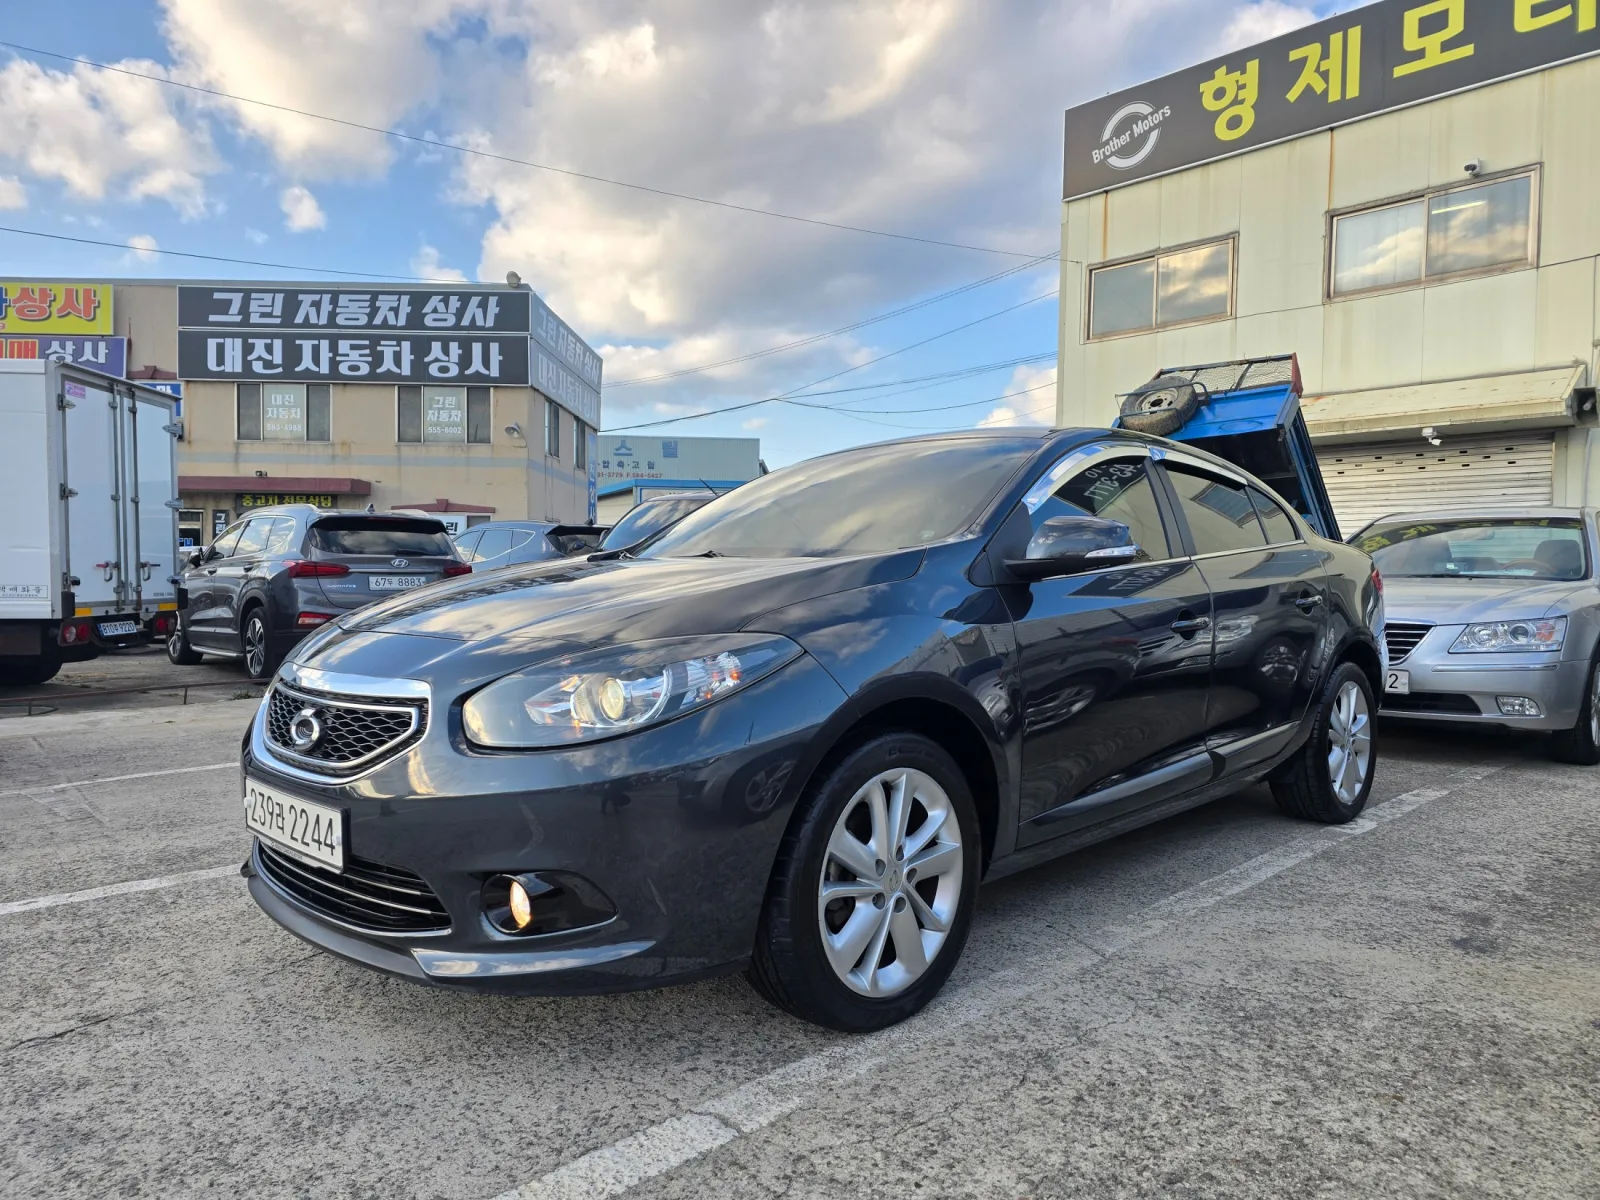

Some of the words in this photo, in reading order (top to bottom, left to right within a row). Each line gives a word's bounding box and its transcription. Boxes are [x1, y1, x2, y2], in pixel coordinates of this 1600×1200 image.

[1092, 130, 1130, 164] Brother
[1132, 105, 1171, 138] Motors
[207, 291, 286, 324] 그린
[293, 292, 413, 328] 자동차
[421, 294, 501, 329] 상사
[45, 340, 109, 364] 상사
[537, 307, 557, 349] 그린
[558, 325, 584, 372] 자동차
[584, 351, 600, 385] 상사
[206, 337, 284, 375] 대진
[294, 339, 414, 377] 자동차
[423, 340, 503, 379] 상사
[538, 352, 557, 393] 대진
[558, 368, 583, 412] 자동차
[271, 393, 295, 406] 대진
[432, 396, 456, 408] 그린
[266, 407, 301, 419] 자동차
[427, 409, 462, 422] 자동차
[242, 494, 279, 507] 중고차
[398, 577, 422, 587] 8883
[118, 621, 135, 633] 9220
[1388, 673, 1399, 689] 2
[250, 787, 285, 835] 239라
[289, 804, 336, 857] 2244
